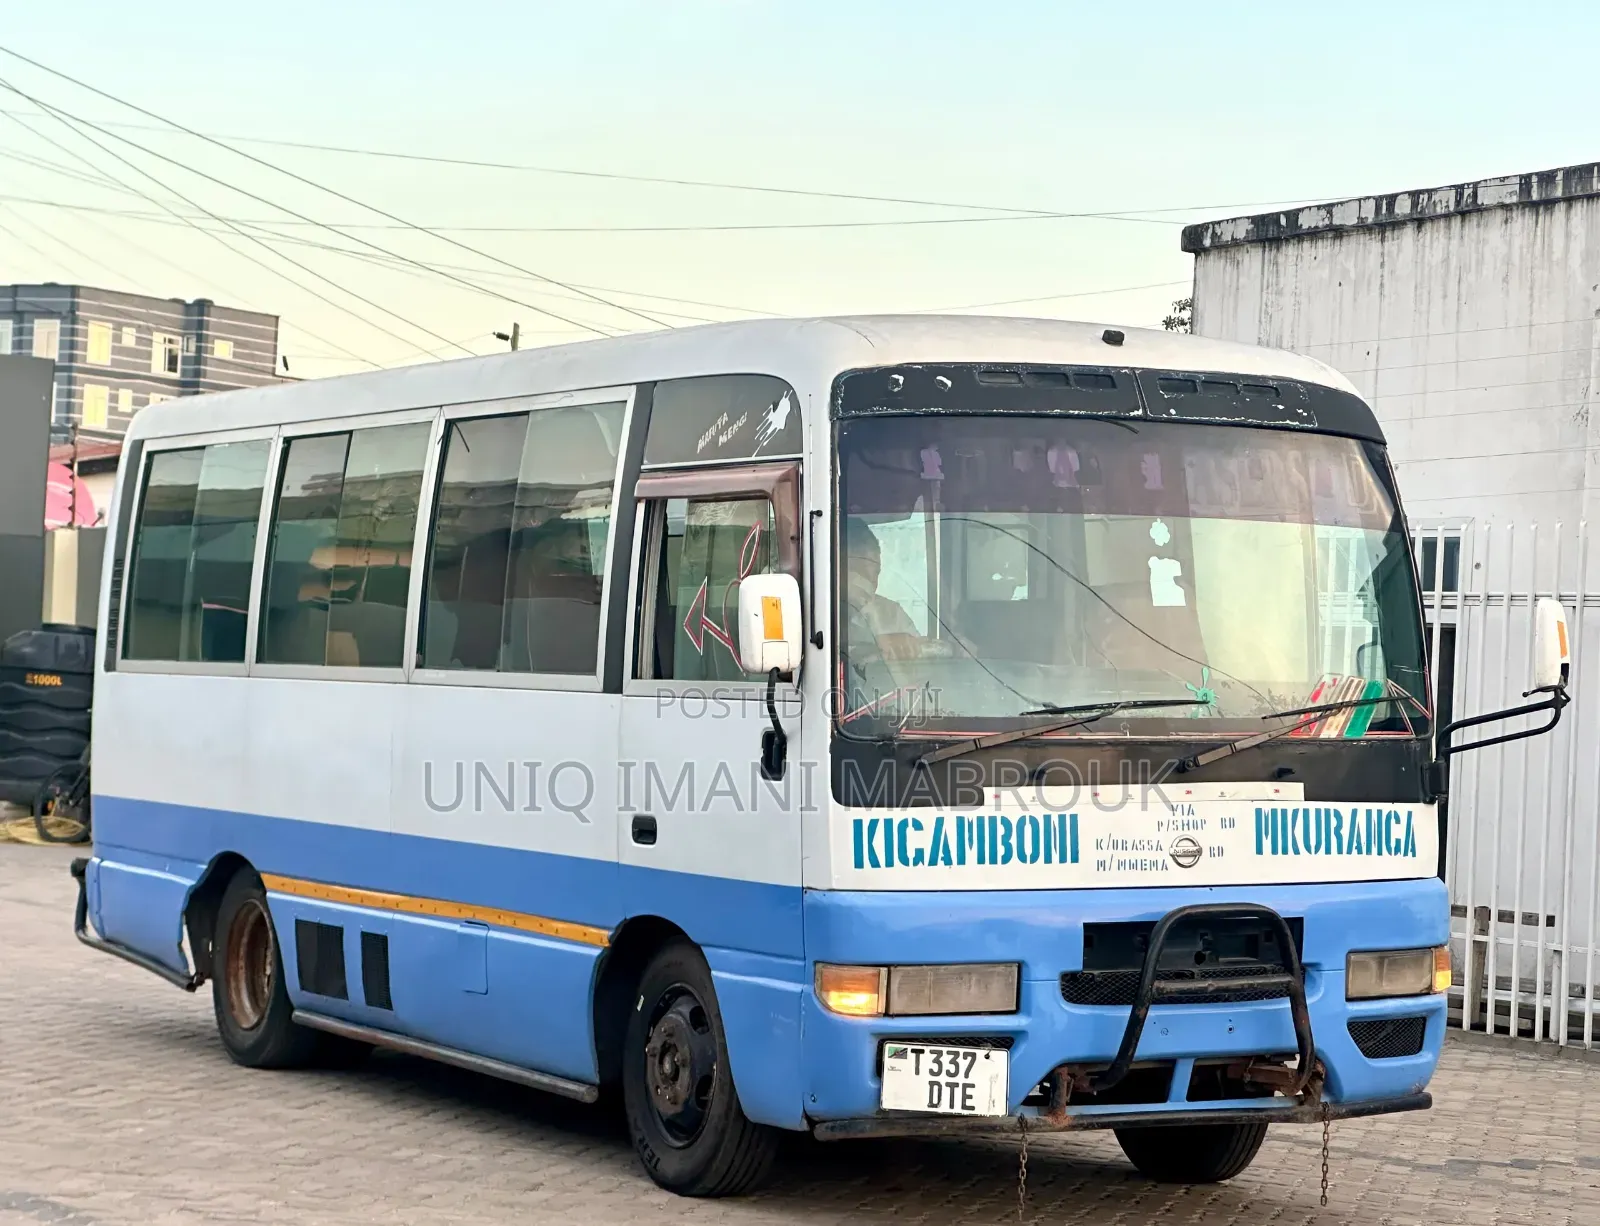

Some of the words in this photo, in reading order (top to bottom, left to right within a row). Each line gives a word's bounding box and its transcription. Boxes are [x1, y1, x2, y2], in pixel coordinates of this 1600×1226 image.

[33, 674, 63, 686] 1000L
[1171, 803, 1195, 816] VIA
[1220, 817, 1236, 829] RD
[1255, 807, 1417, 857] MKURANGA
[853, 813, 1080, 869] KIGAMBONI
[1209, 845, 1224, 857] RD
[927, 1080, 976, 1111] DTE
